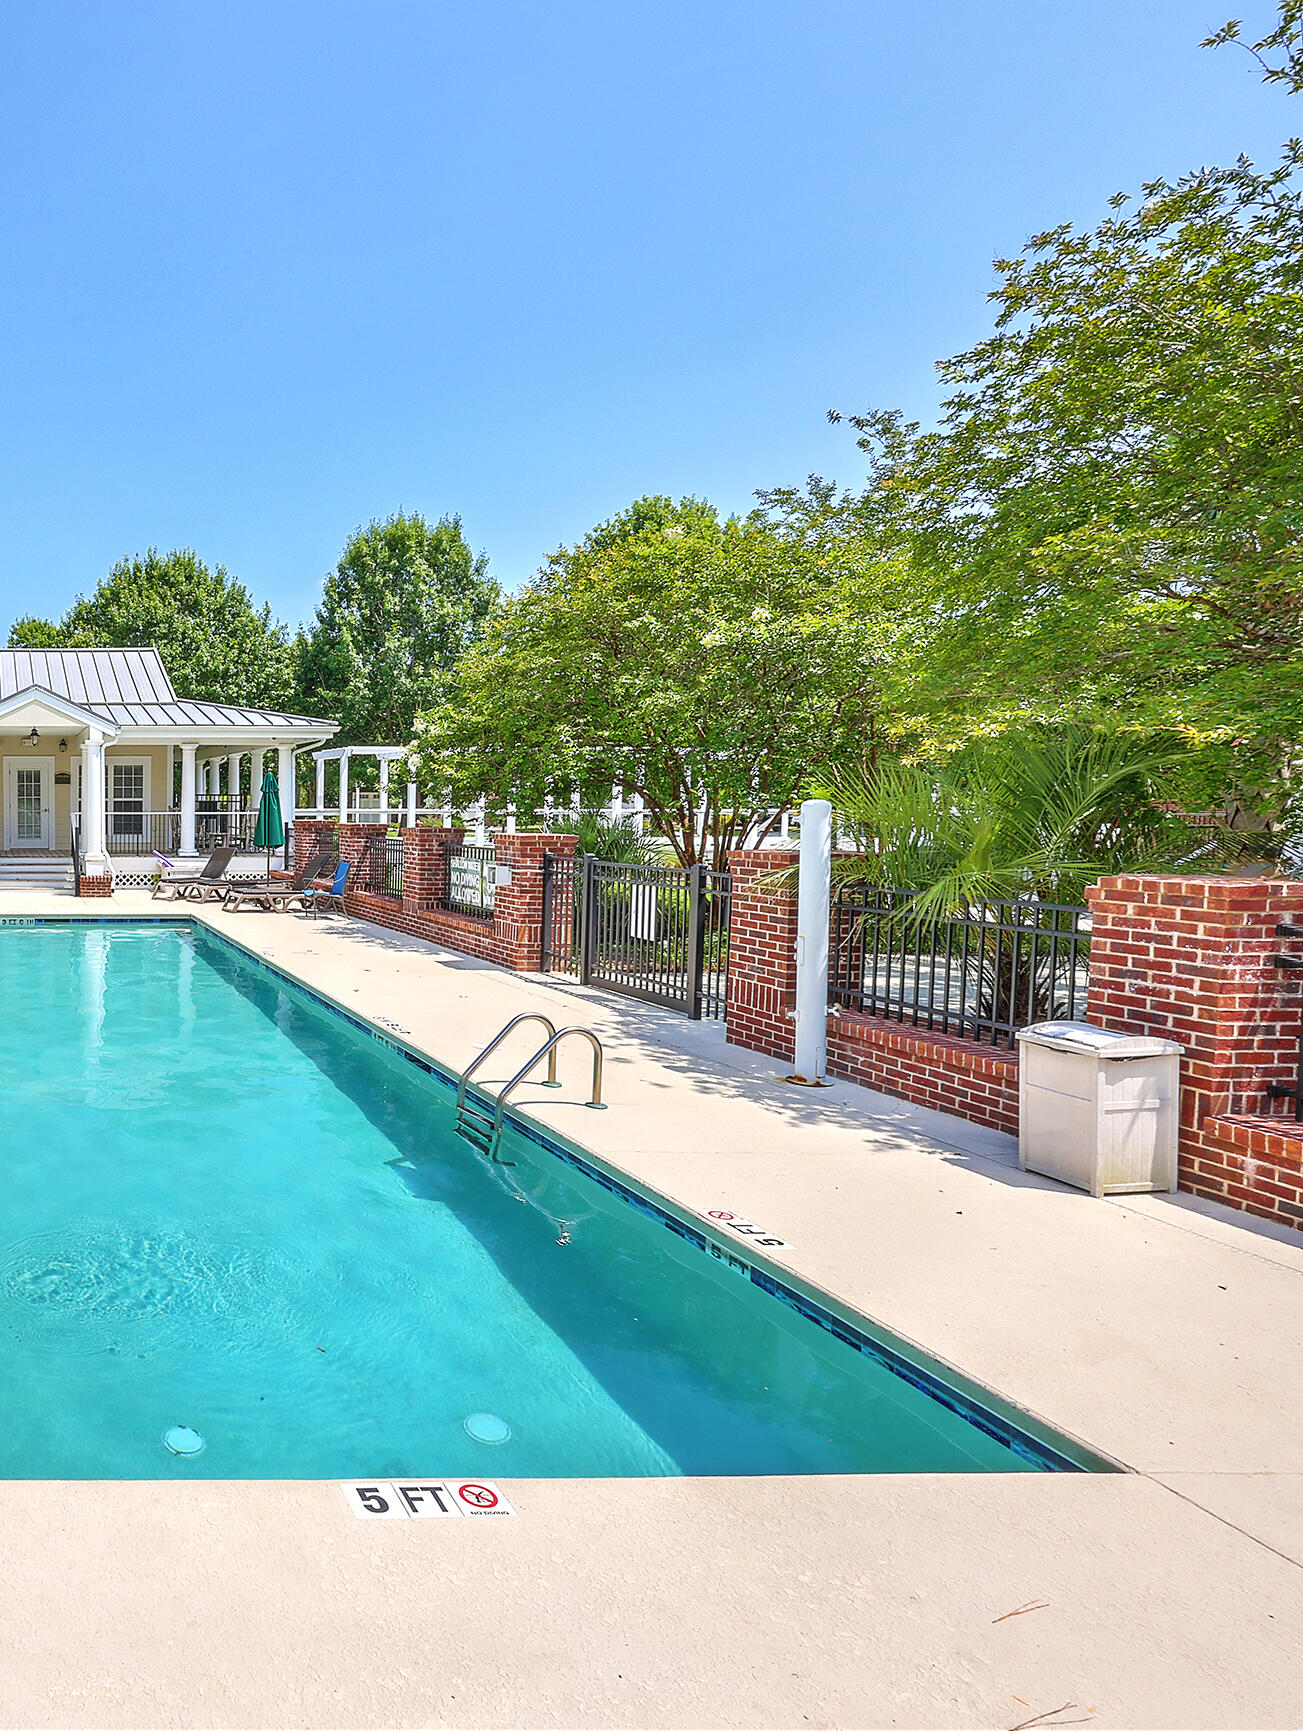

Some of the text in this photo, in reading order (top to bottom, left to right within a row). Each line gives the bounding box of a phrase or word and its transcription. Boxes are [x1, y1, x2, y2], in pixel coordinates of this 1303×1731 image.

[451, 870, 460, 884] NO
[726, 1222, 785, 1246] 5 FT
[710, 1243, 750, 1275] 5 FT
[355, 1486, 449, 1513] 5 FT
